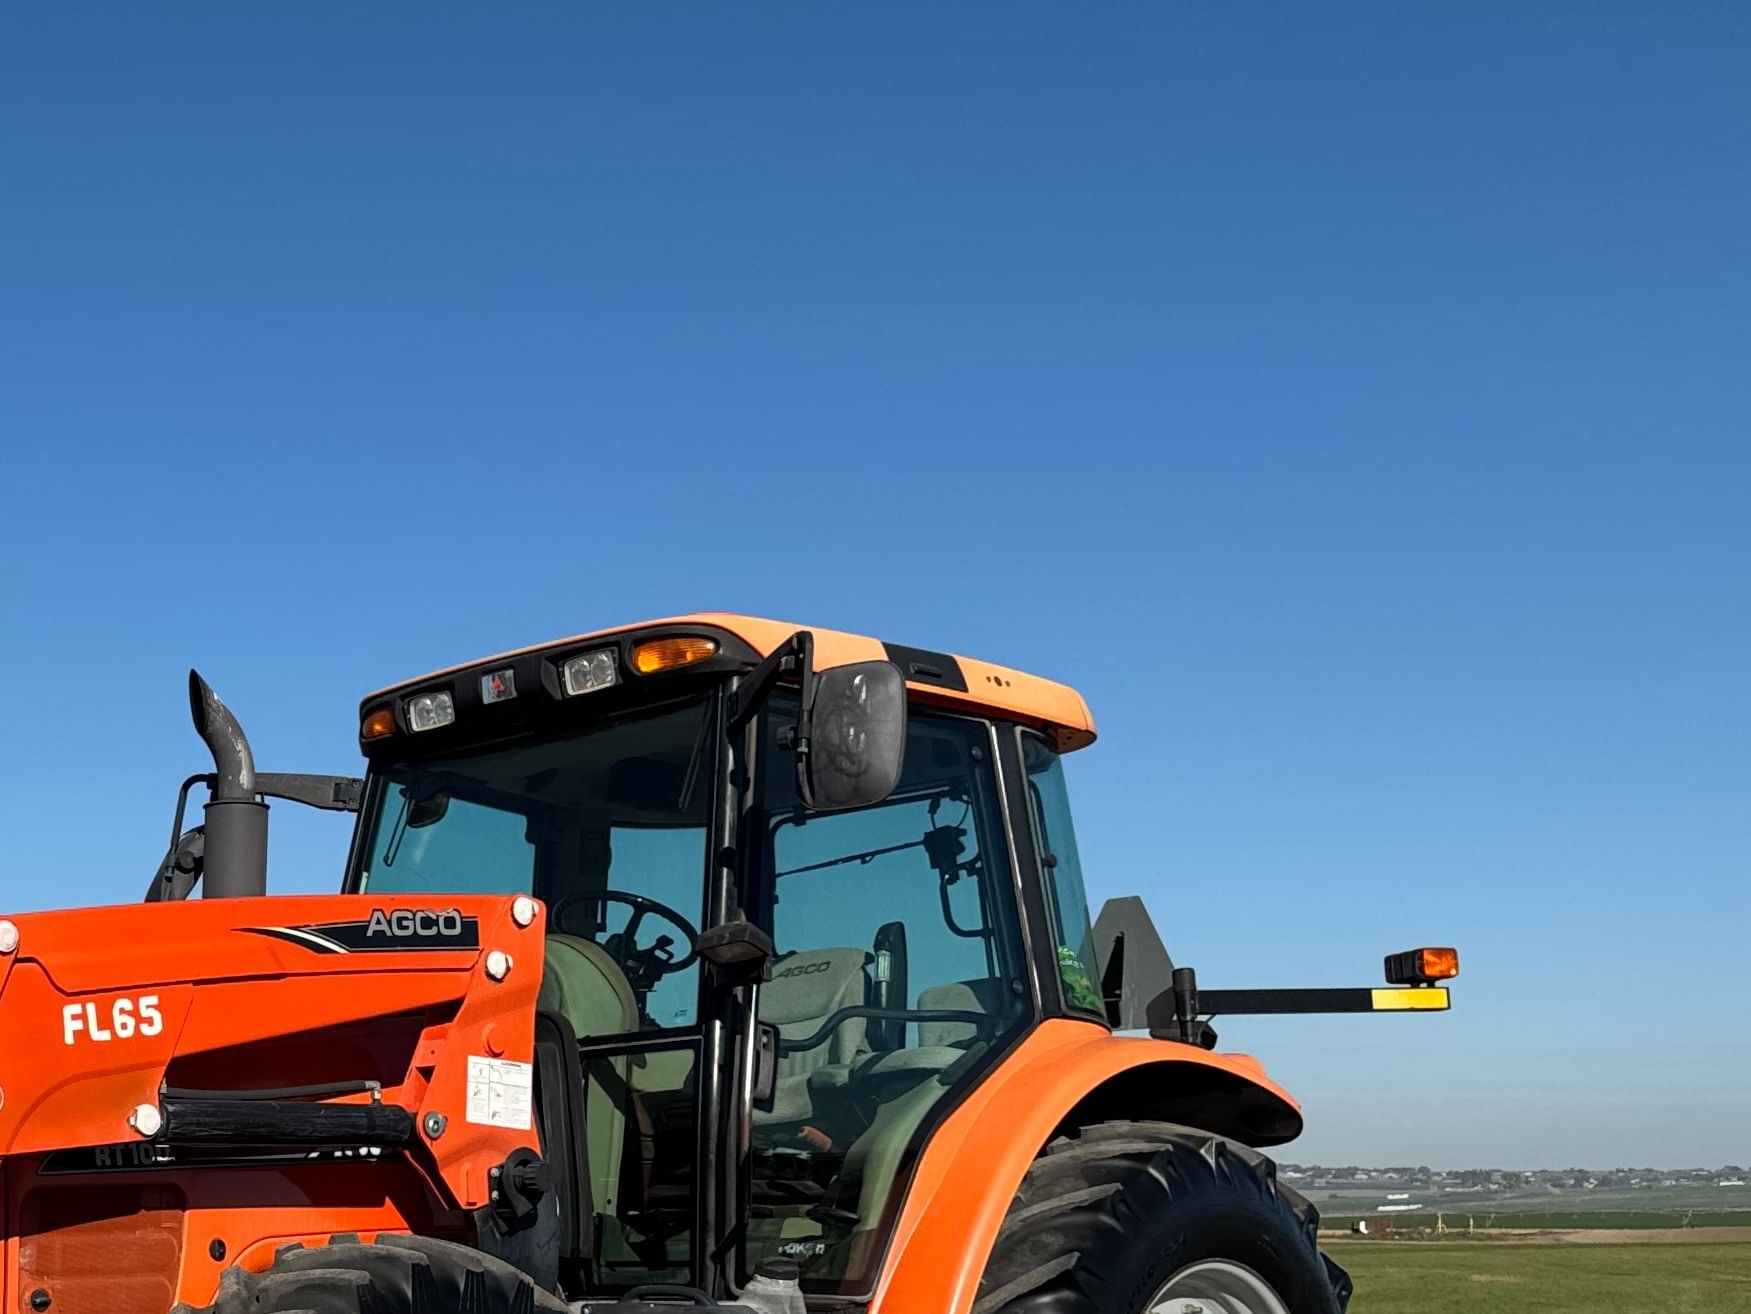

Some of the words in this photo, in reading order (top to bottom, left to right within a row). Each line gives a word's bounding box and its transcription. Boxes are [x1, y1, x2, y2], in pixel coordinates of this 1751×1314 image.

[366, 910, 462, 937] AGCO
[772, 961, 831, 980] AGCO
[62, 995, 163, 1046] FL65
